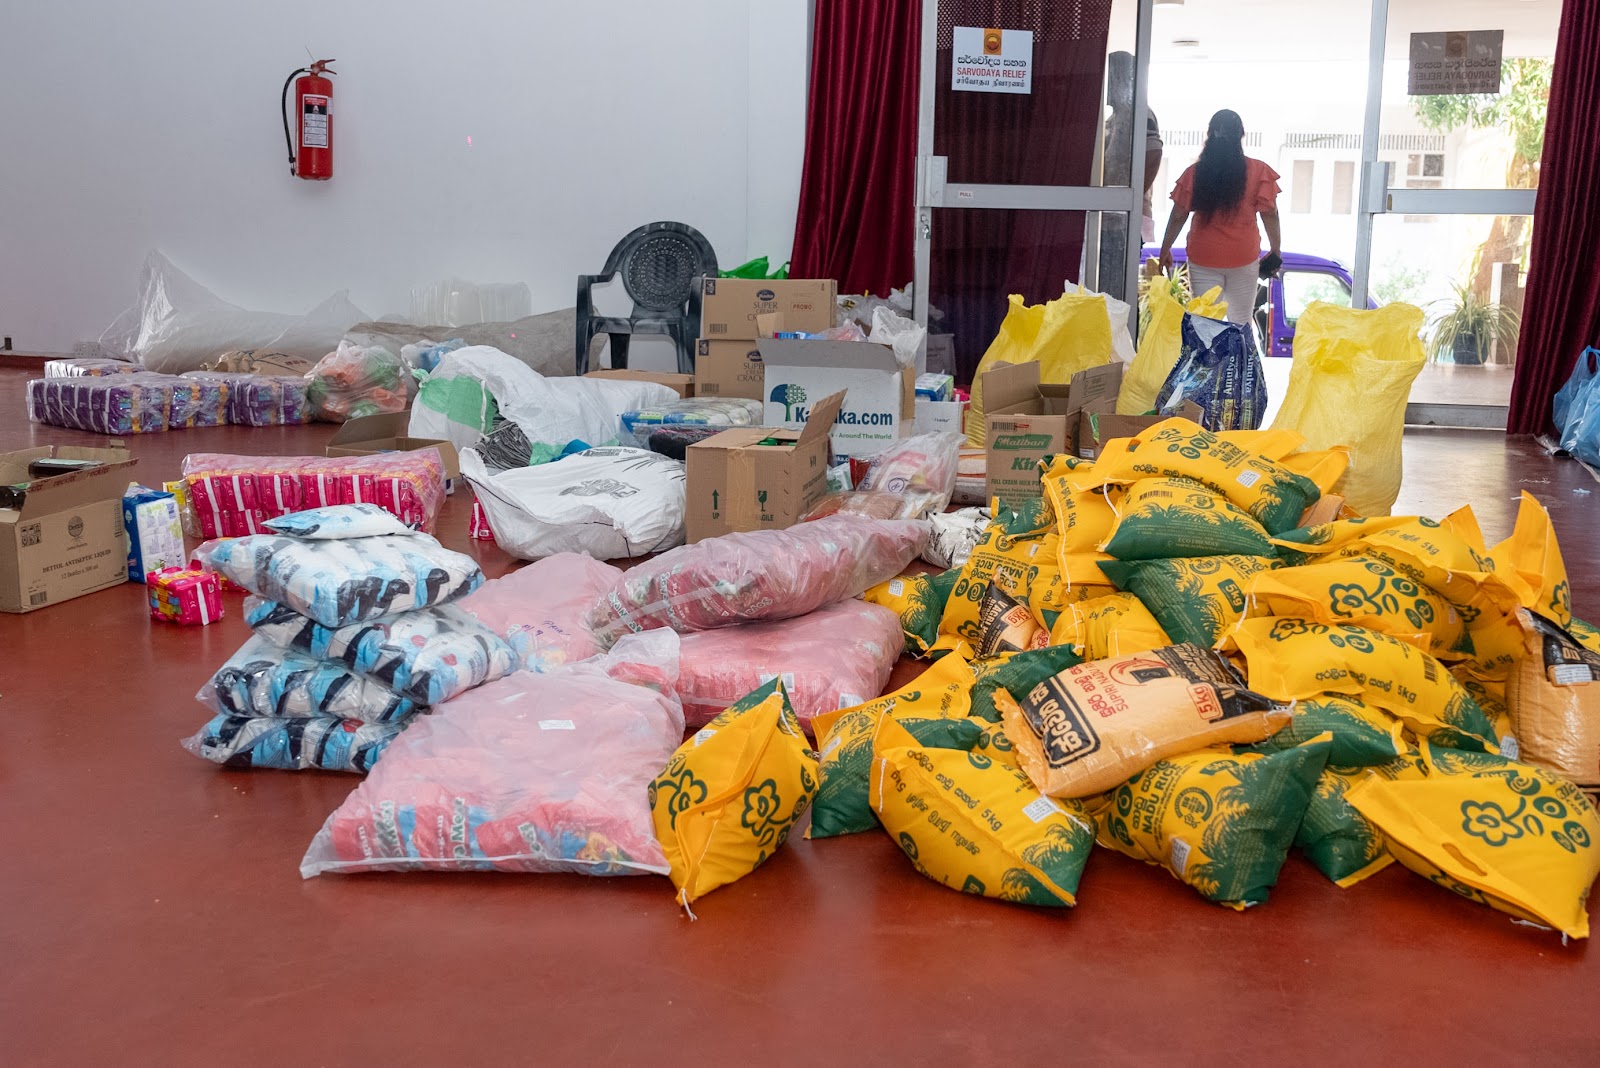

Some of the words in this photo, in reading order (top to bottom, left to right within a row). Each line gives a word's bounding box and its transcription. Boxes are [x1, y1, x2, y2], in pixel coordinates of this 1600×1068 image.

[957, 67, 1000, 77] SARVODAYA
[1003, 69, 1026, 78] RELIEF
[1004, 59, 1026, 67] සහන
[753, 301, 778, 309] SUPER
[1223, 356, 1235, 395] Amulya
[796, 407, 893, 426] Kaka.com
[997, 438, 1045, 447] Maliban
[1011, 457, 1040, 471] Kir
[68, 523, 83, 531] Dettol
[761, 514, 774, 522] GILE
[1068, 512, 1077, 528] 5kg
[1420, 541, 1440, 556] 5kg
[42, 561, 64, 574] DETTOL
[65, 554, 93, 567] ANTISEPTIC
[94, 549, 111, 559] LIQUID
[974, 558, 994, 571] RICE
[1231, 556, 1255, 576] RICE
[1224, 582, 1243, 608] 5kg
[1007, 607, 1030, 625] 5kg
[1092, 666, 1112, 687] NADU
[1315, 668, 1347, 681] අරලිය
[1397, 683, 1417, 704] 5kg
[1107, 684, 1129, 713] SUPIRI
[1193, 686, 1214, 714] 5kg
[890, 770, 906, 793] 5kg
[935, 772, 954, 791] නාඩු
[954, 785, 981, 810] සහල්
[981, 808, 1002, 832] 5kg
[1142, 792, 1161, 834] NADU
[1156, 763, 1179, 792] RICE
